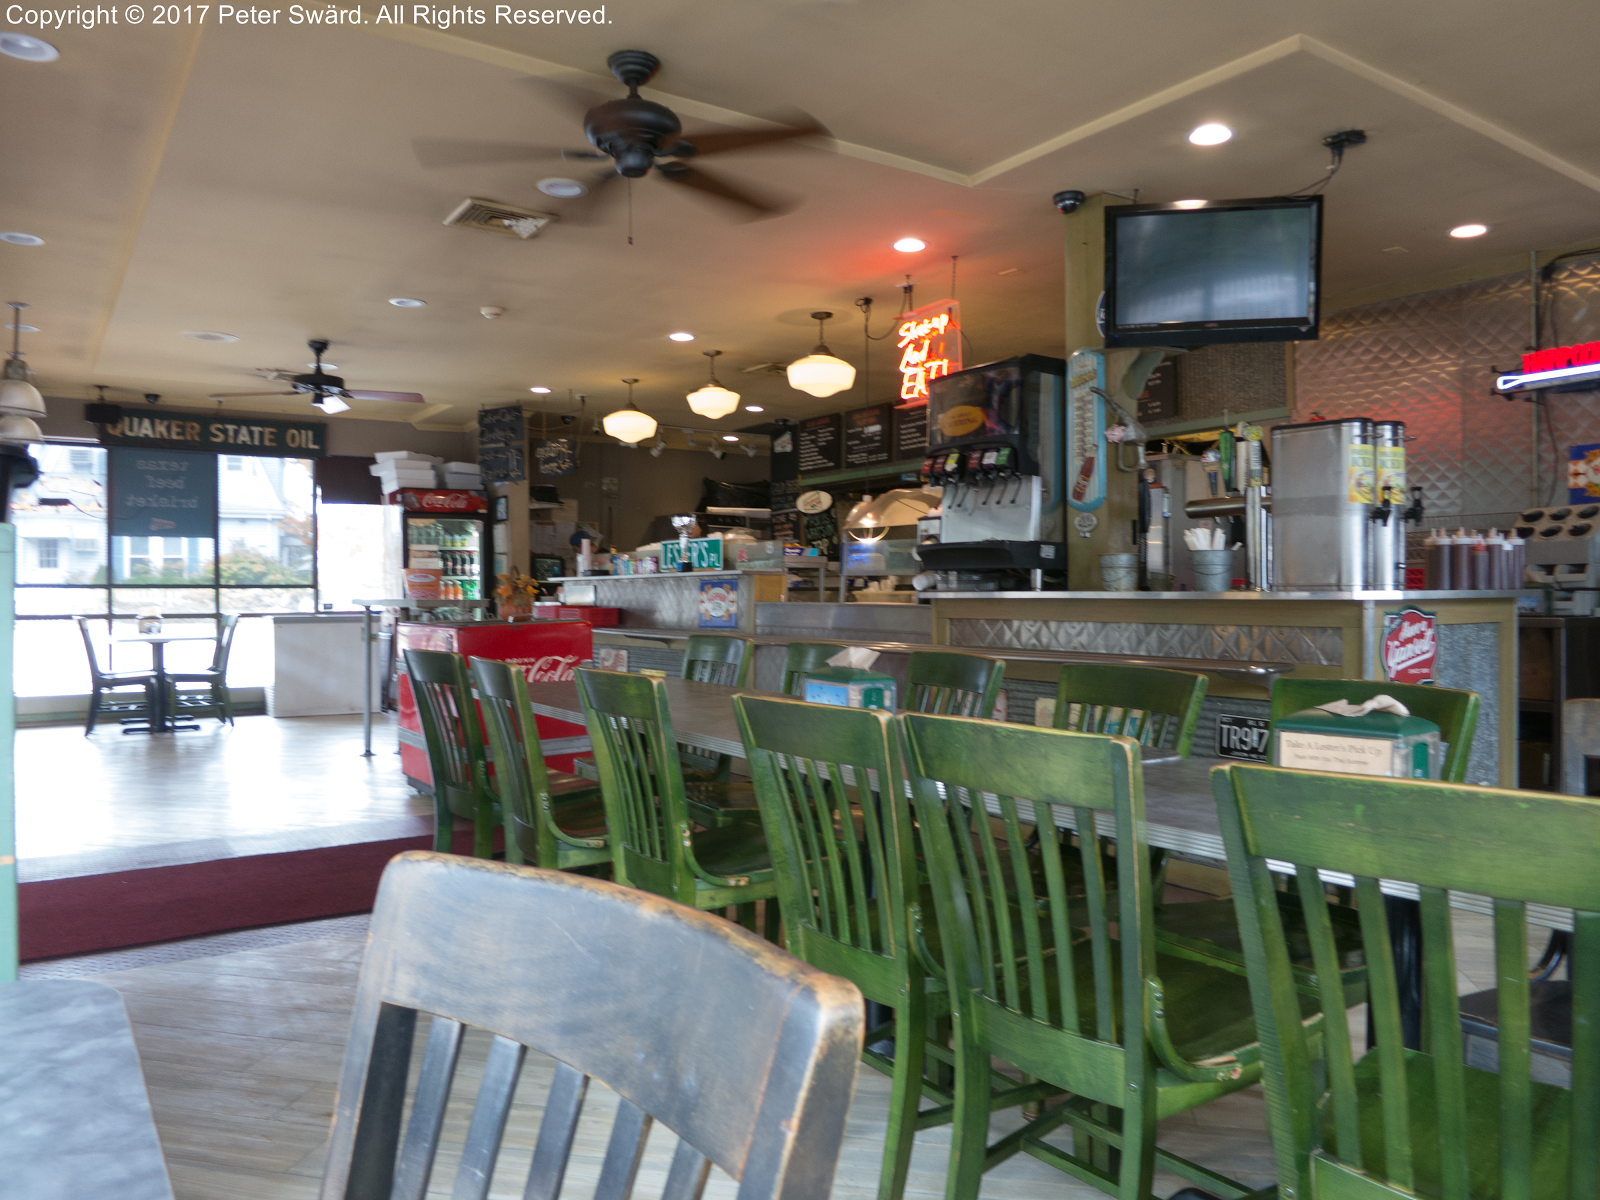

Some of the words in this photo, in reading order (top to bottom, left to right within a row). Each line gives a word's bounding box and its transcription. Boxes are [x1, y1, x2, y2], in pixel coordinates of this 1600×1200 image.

[1522, 341, 1600, 374] HARPOO
[107, 416, 201, 442] QUAKER
[209, 423, 278, 447] STATE
[286, 428, 321, 450] OIL
[422, 491, 469, 509] Coca-Cola
[661, 541, 709, 569] LESR'S
